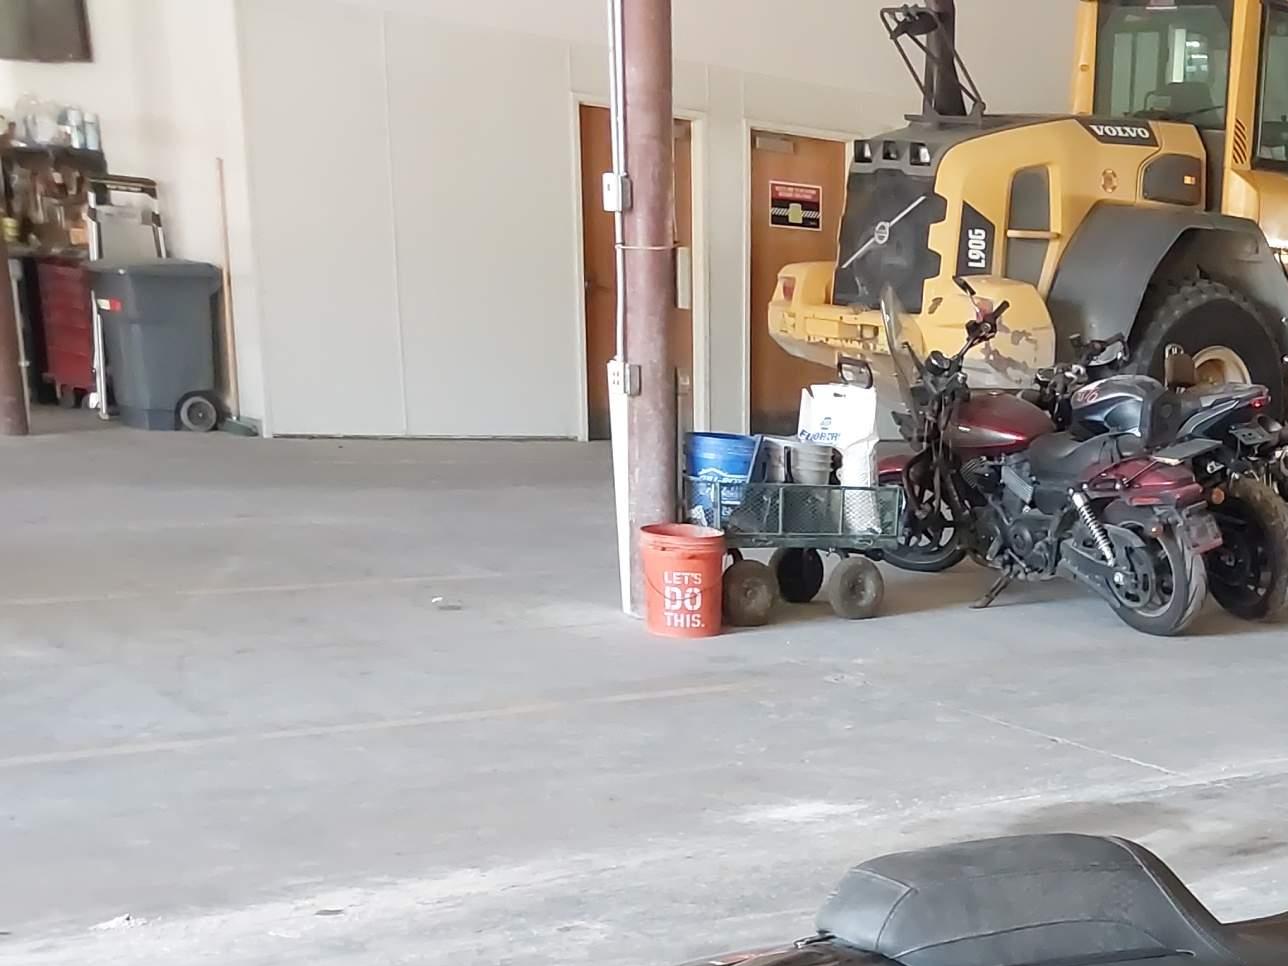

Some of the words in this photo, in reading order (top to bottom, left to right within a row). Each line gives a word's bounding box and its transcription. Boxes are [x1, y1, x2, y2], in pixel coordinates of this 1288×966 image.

[1089, 125, 1150, 139] VOLVO
[968, 228, 986, 268] L90G
[664, 571, 702, 585] LET'S
[664, 586, 702, 611] DO
[664, 611, 705, 628] THIS.
